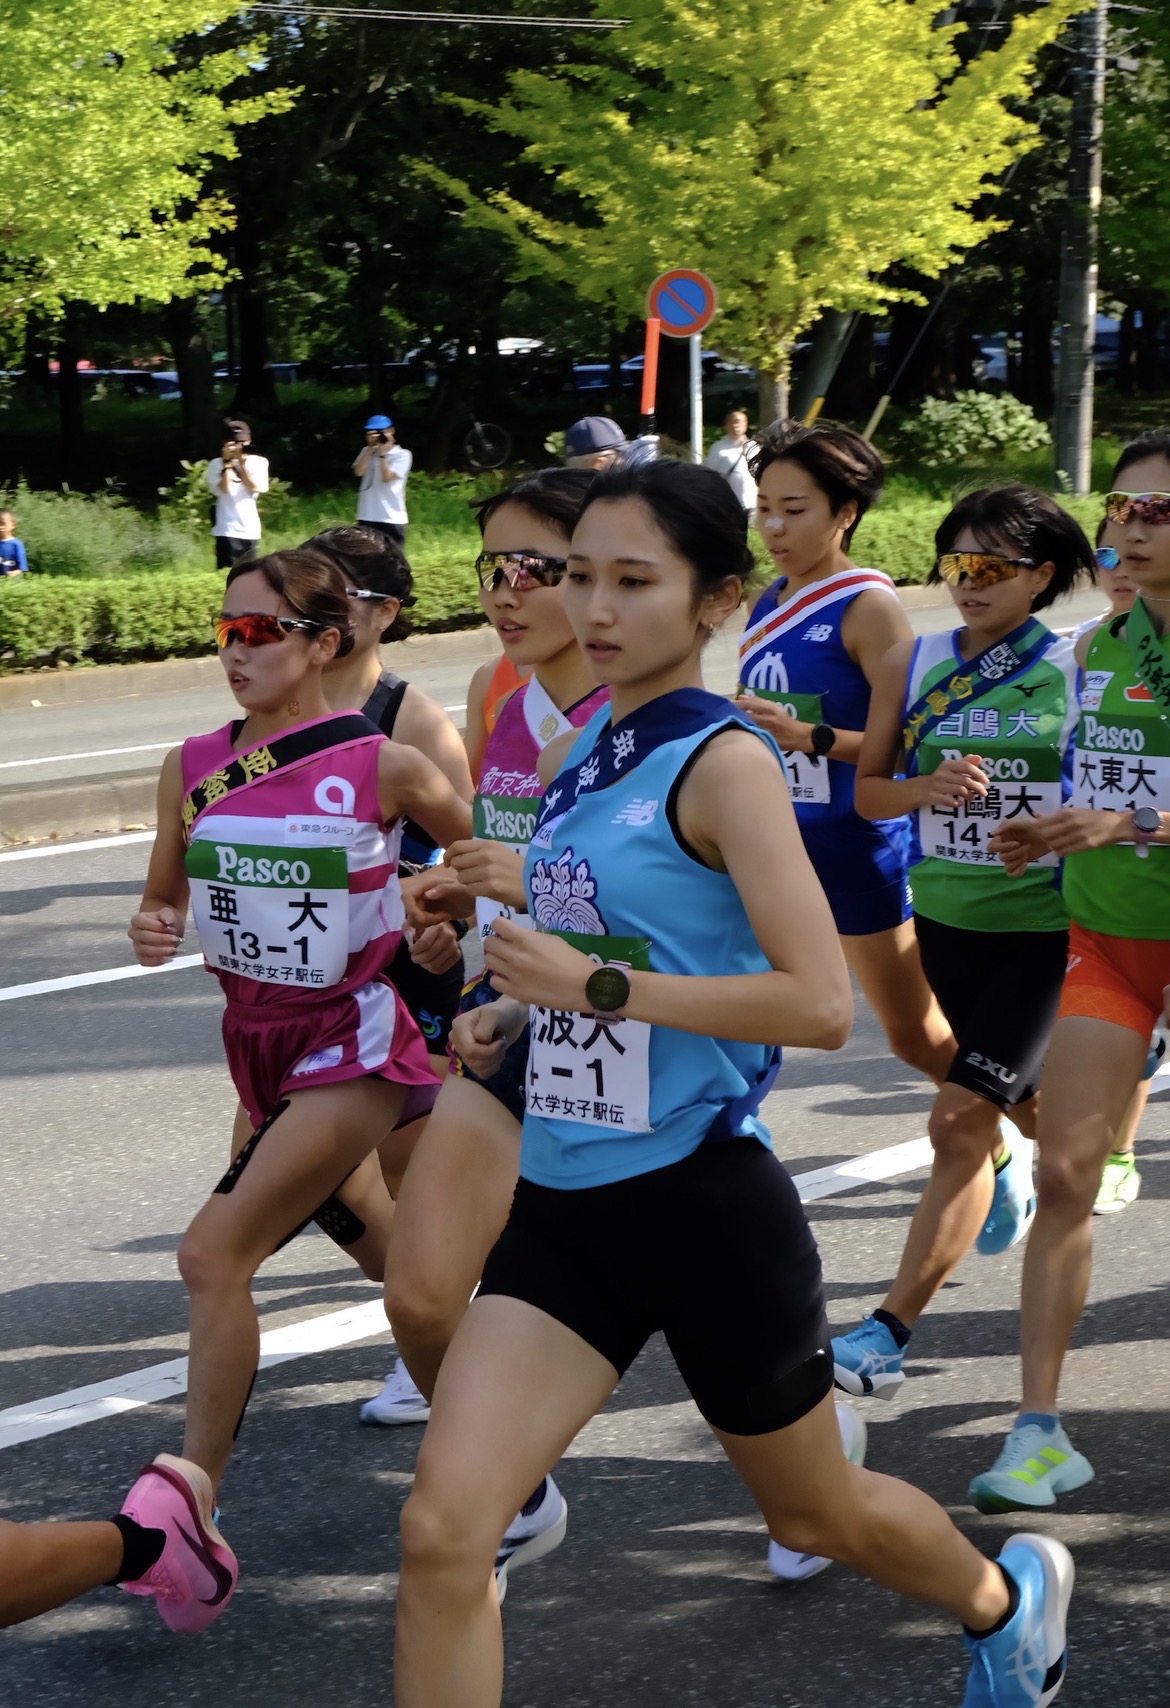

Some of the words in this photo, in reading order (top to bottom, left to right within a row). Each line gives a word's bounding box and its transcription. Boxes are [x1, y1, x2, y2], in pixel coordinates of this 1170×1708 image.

[1083, 715, 1145, 752] Pasco
[941, 749, 1030, 780] sco
[1079, 754, 1158, 797] 大東大
[215, 845, 311, 886] Pasco
[222, 928, 309, 965] 13-1
[218, 954, 325, 984] 関東大学女子駅伝
[531, 1005, 627, 1056] 波大
[965, 1051, 1019, 1084] 2XU
[530, 1092, 625, 1126] 大学女子駅伝
